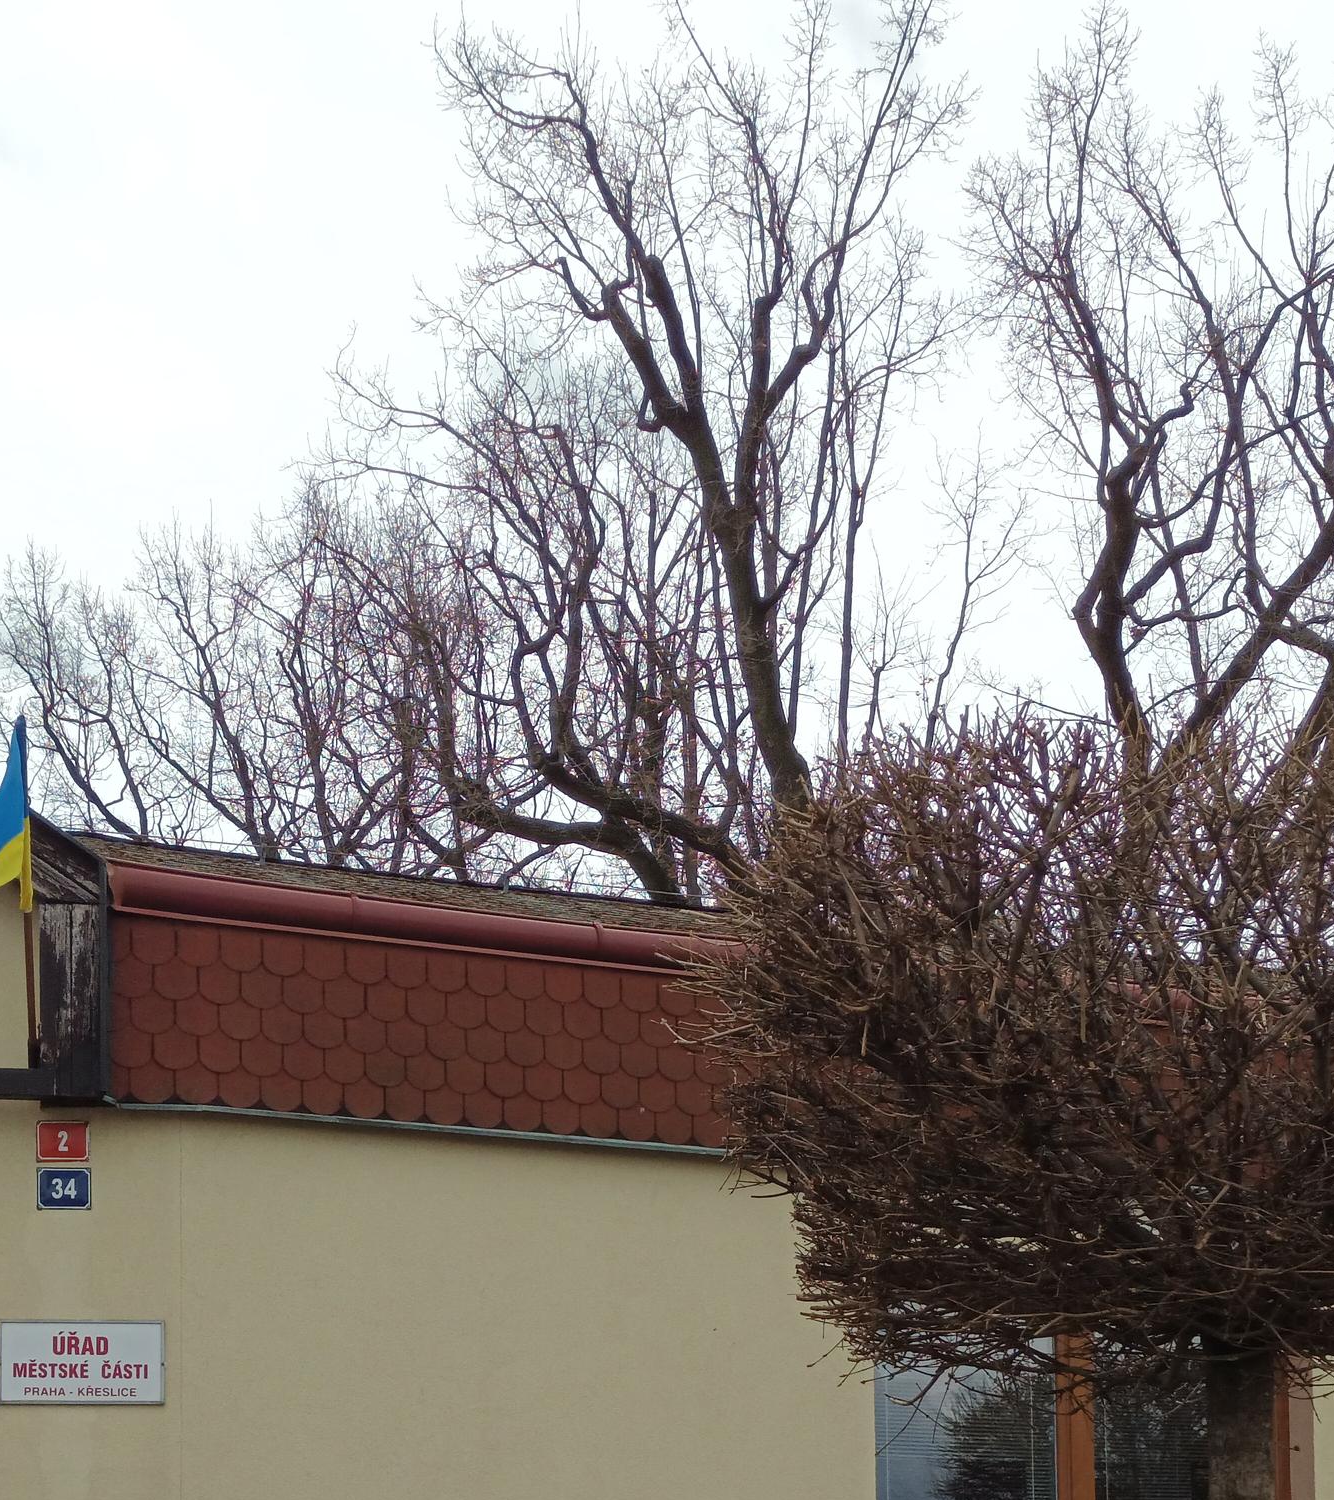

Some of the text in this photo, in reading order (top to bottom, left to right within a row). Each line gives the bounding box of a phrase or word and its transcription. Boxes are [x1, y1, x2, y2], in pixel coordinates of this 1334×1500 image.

[57, 1130, 69, 1152] 2
[51, 1178, 77, 1199] 34
[52, 1331, 109, 1356] ÚŘAD
[12, 1359, 149, 1379] MĚSTSKÉ ČÁSTI
[23, 1386, 66, 1397] PRAHA
[77, 1385, 137, 1397] KŘESLICE
